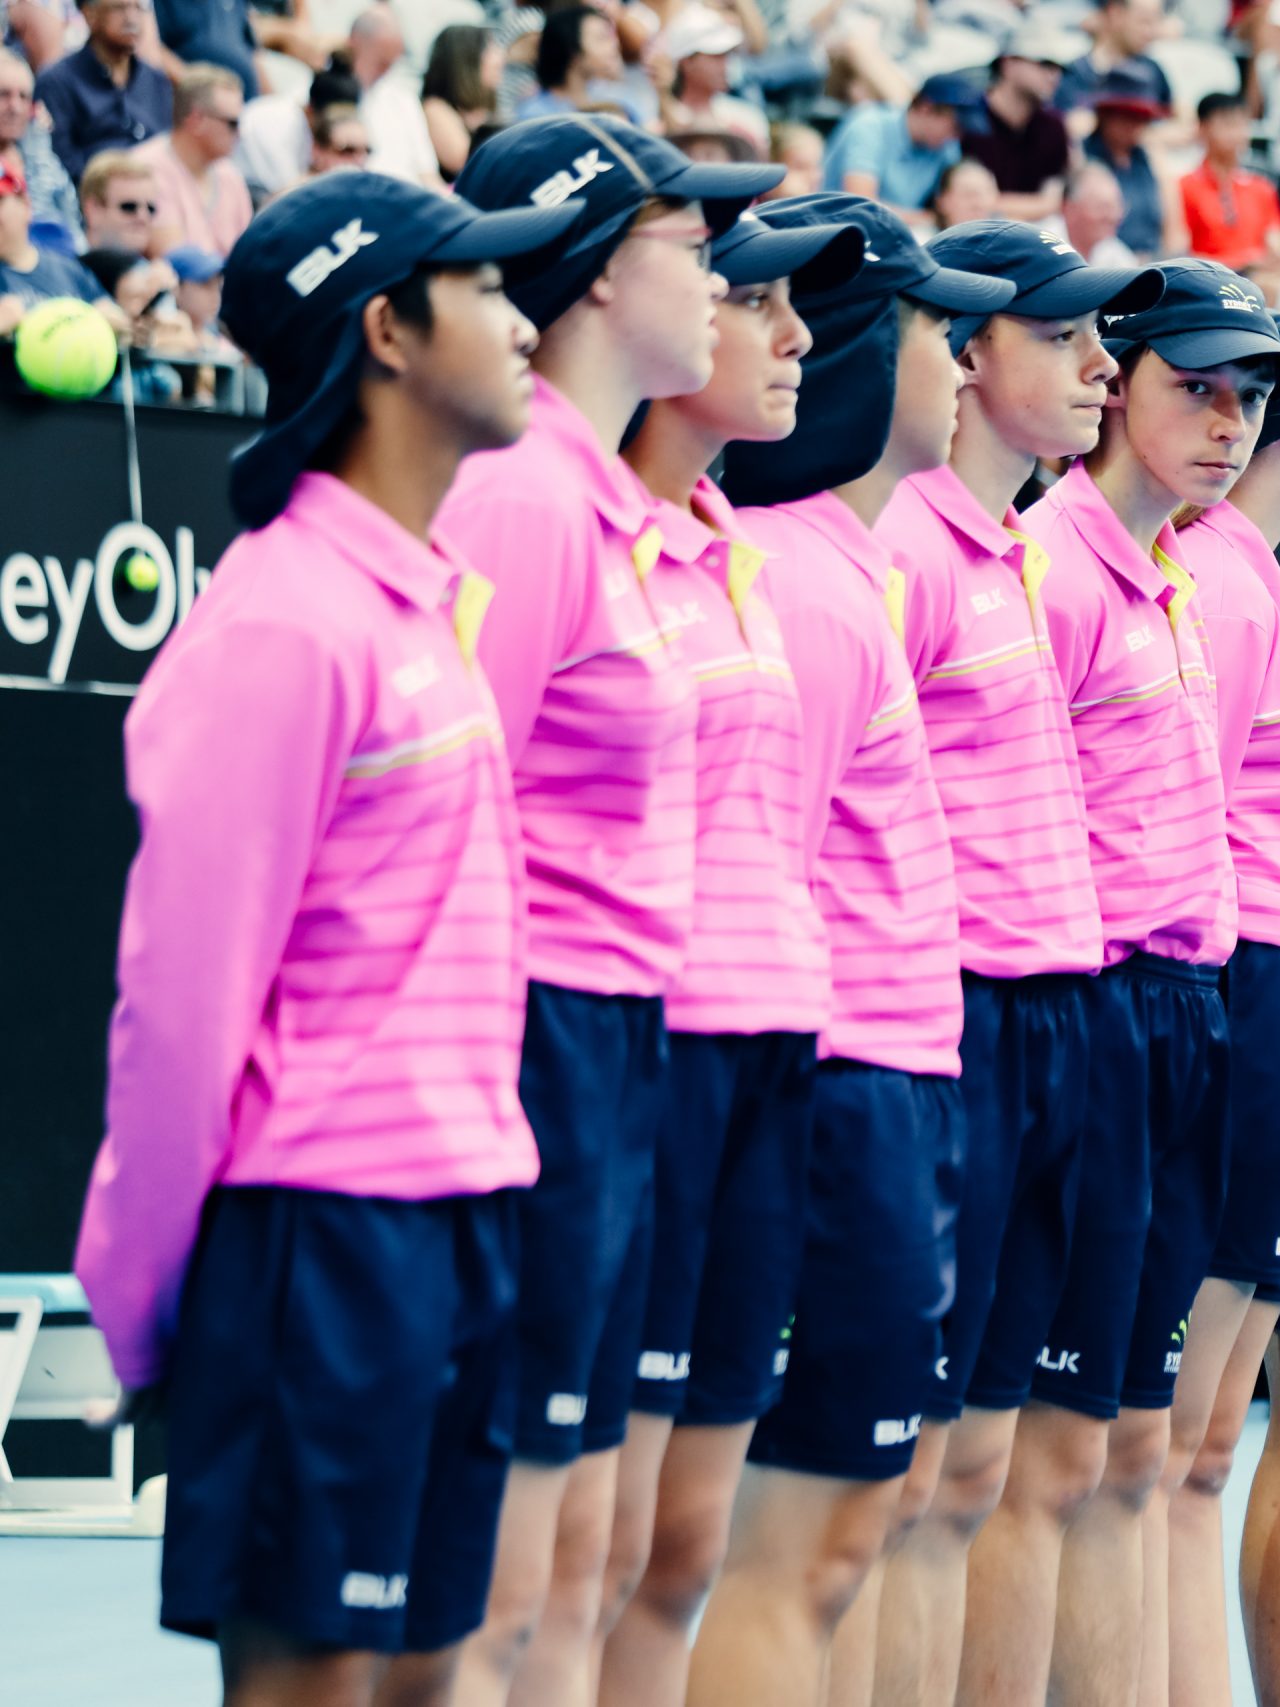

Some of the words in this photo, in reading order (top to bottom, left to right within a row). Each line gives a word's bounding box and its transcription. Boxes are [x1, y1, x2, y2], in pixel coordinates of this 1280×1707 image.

[285, 217, 380, 298] BLK
[970, 587, 1008, 616] BLK
[1124, 624, 1157, 654] BLK
[1036, 1345, 1081, 1374] LK
